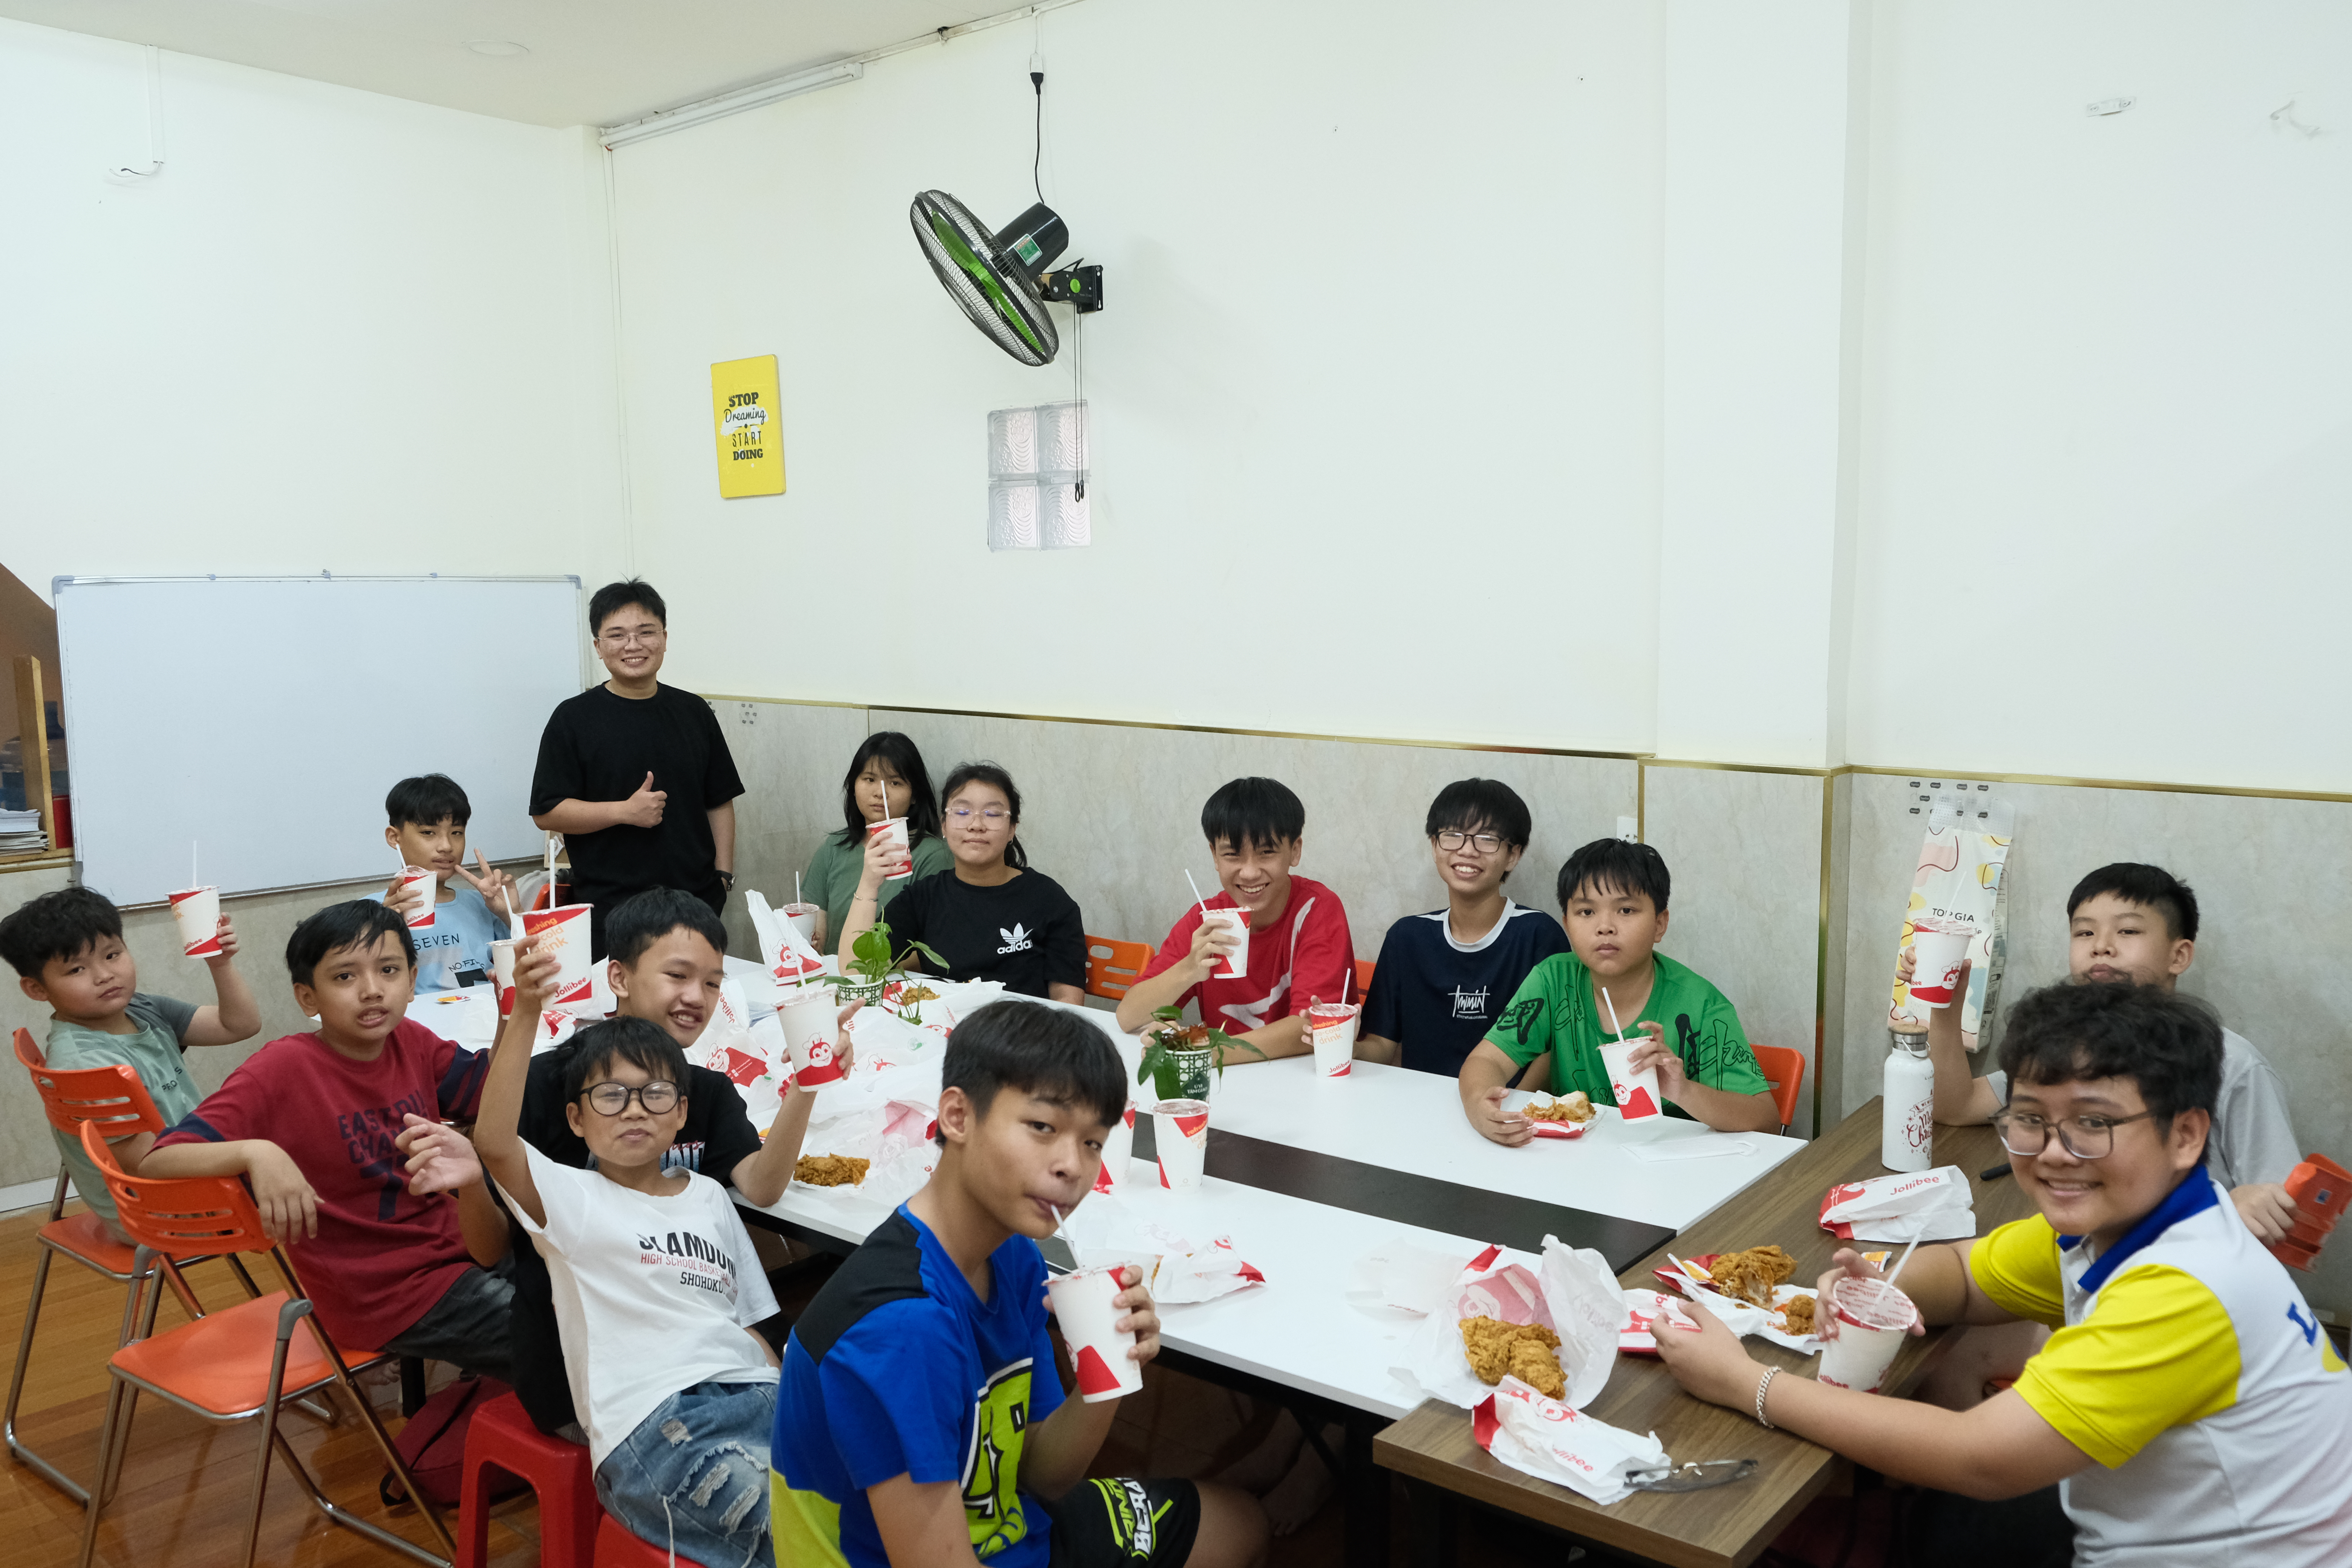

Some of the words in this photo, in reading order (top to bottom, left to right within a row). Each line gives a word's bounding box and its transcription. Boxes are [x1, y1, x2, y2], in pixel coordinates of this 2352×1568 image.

[729, 392, 759, 407] STOP
[724, 408, 766, 425] Dreaming
[732, 430, 762, 447] START
[733, 448, 763, 461] DOING
[1955, 913, 1974, 922] GIA
[413, 933, 459, 951] SEVEN
[554, 977, 586, 997] Jollibee
[1319, 1033, 1343, 1044] drink
[338, 1107, 391, 1140] EAST
[1890, 1176, 1940, 1195] Jollibee
[640, 1253, 662, 1265] HIGH
[666, 1256, 697, 1270] SCHOOL
